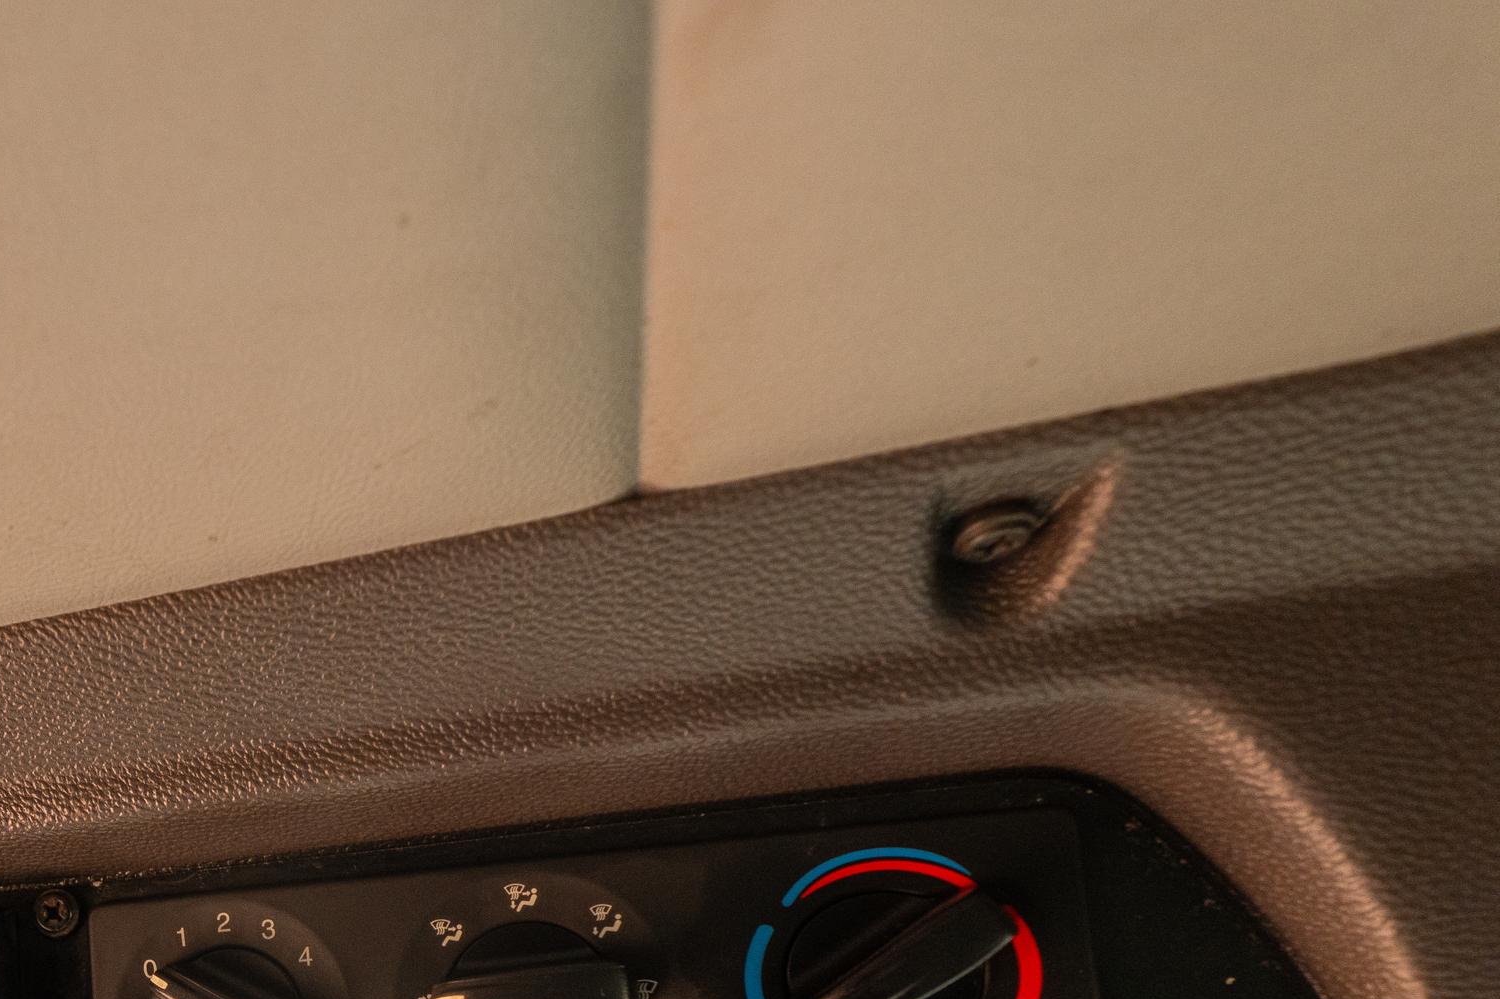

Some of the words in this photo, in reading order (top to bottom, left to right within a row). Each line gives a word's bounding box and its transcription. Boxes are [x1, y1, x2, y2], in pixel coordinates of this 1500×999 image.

[216, 912, 232, 933] 2
[261, 918, 277, 940] 3
[176, 927, 187, 947] 1
[298, 946, 314, 967] 4
[143, 959, 159, 979] 0
